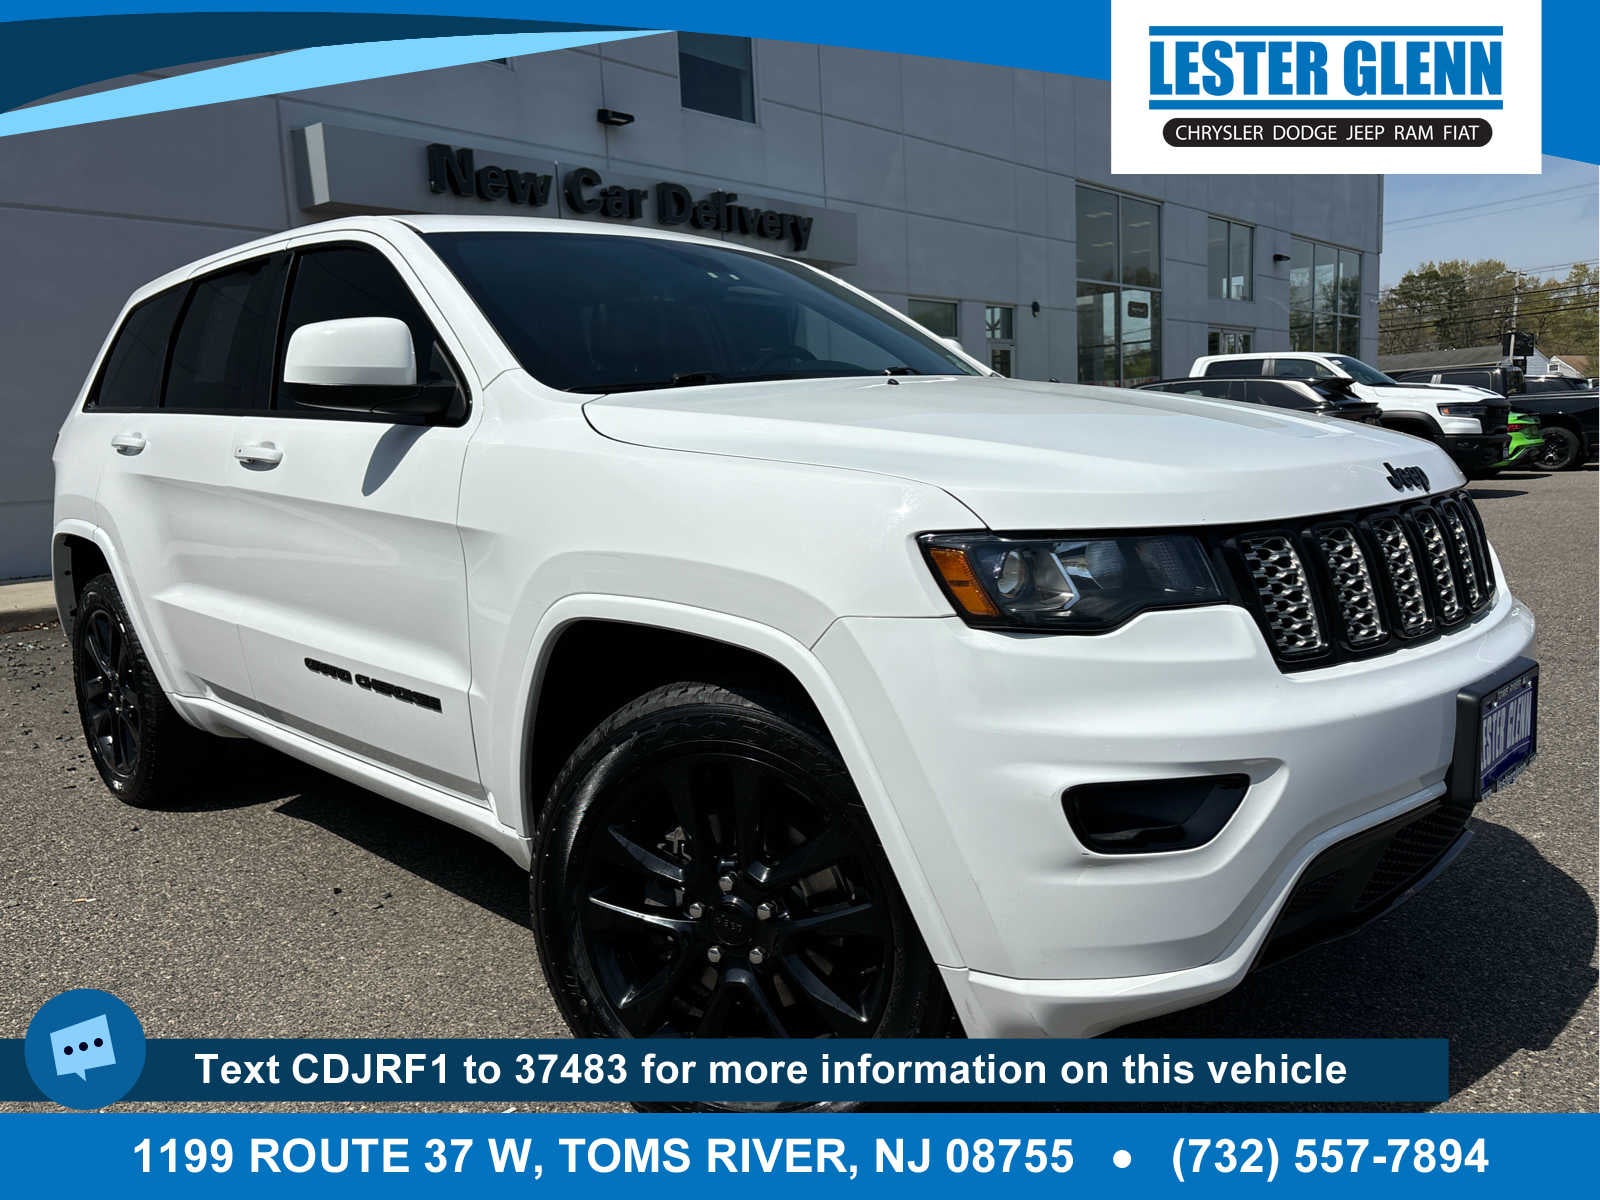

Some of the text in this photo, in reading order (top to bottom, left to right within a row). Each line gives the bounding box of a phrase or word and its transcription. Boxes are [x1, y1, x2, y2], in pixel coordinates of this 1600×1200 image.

[426, 142, 814, 252] New Car Delivery
[1382, 462, 1431, 493] Jeep
